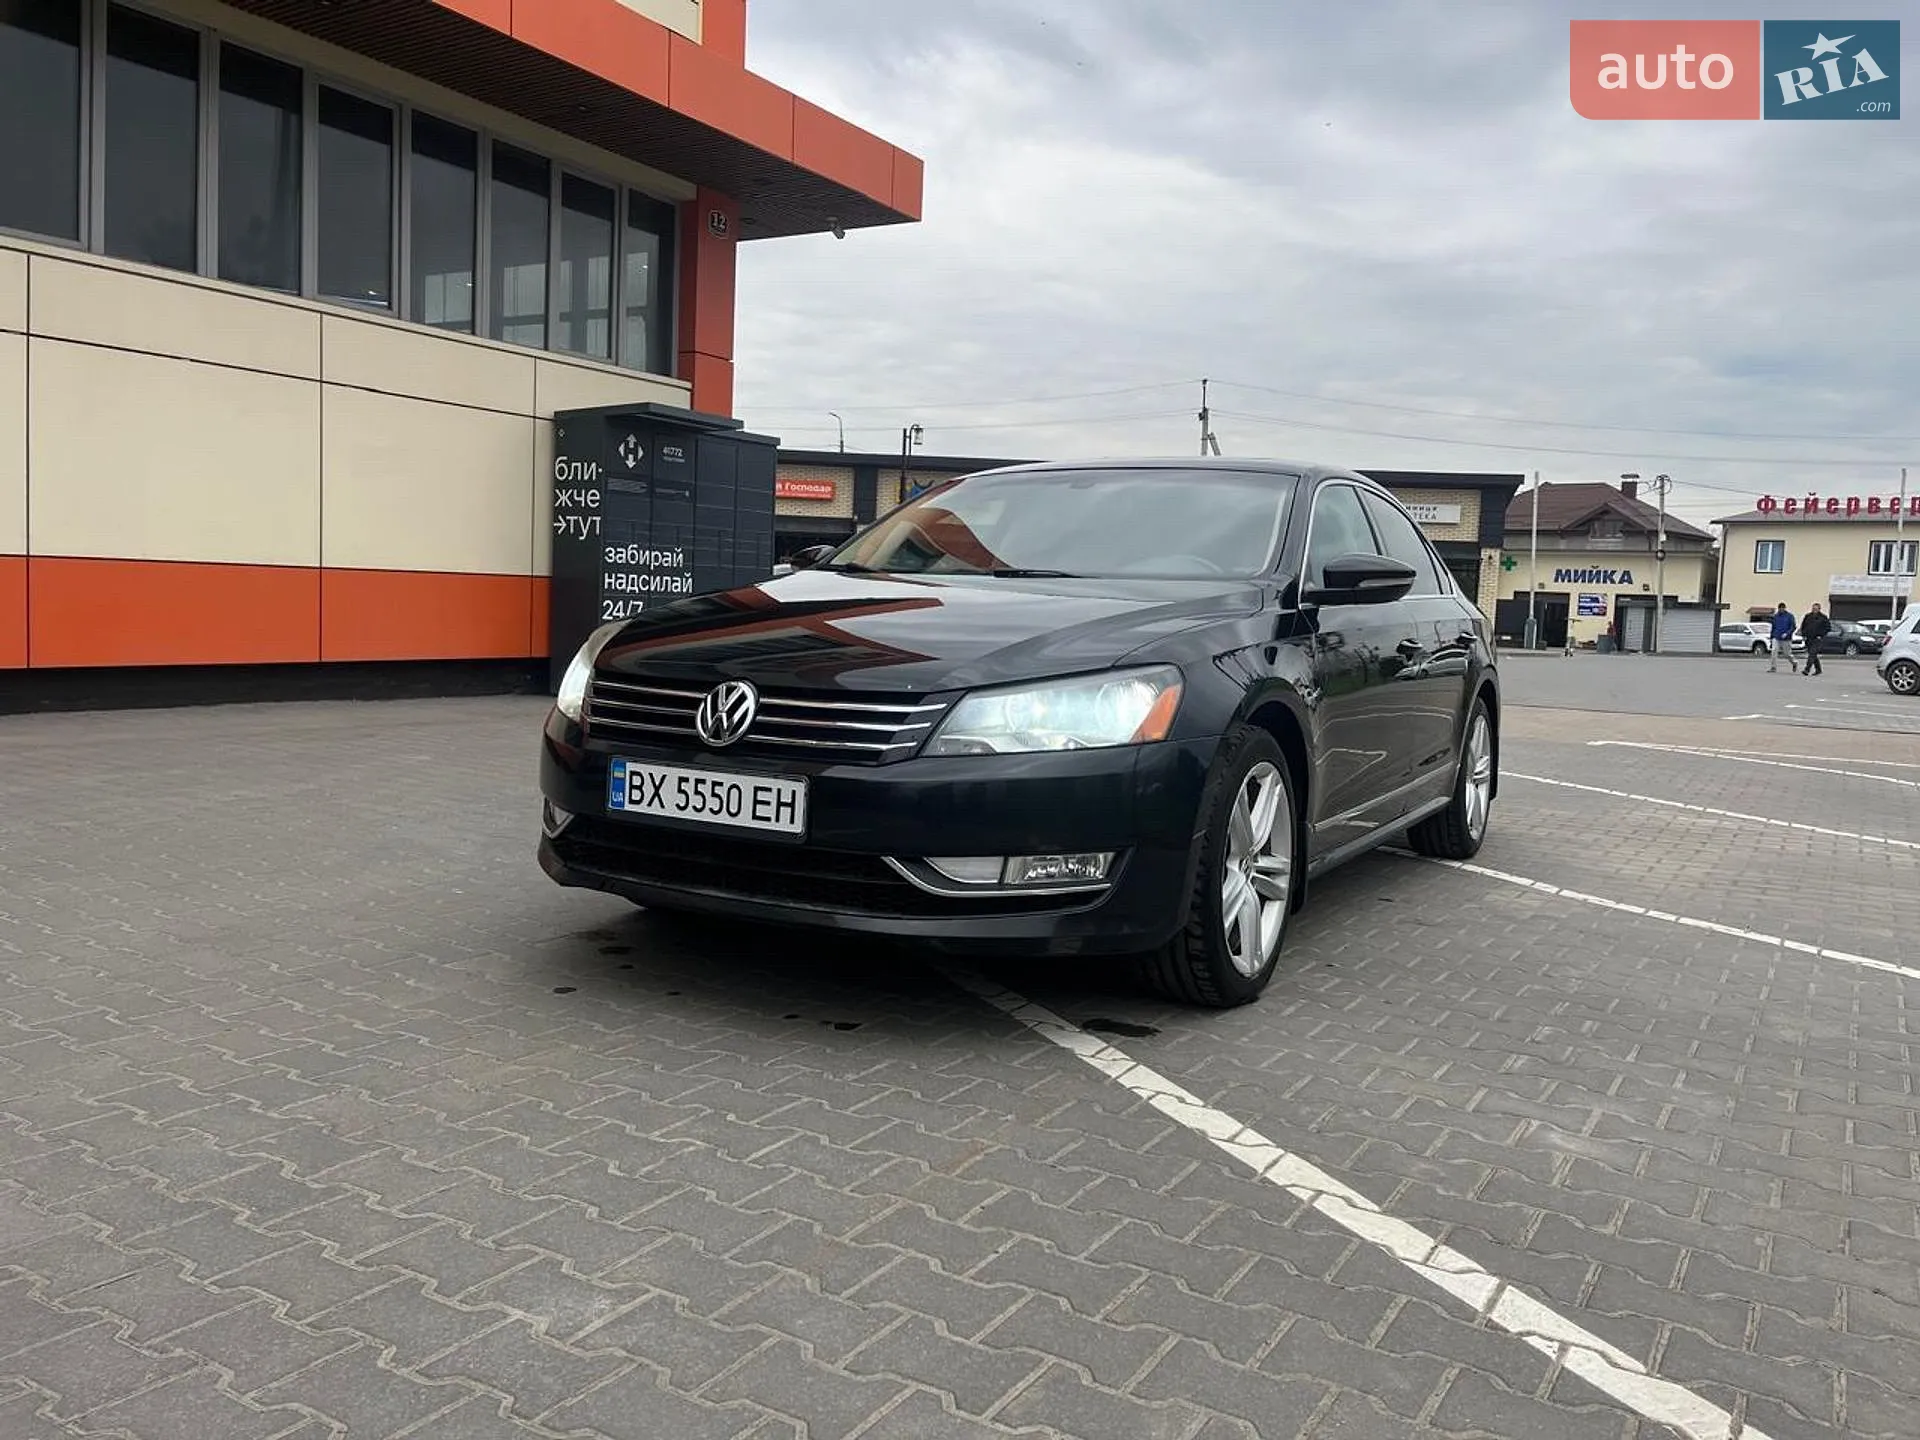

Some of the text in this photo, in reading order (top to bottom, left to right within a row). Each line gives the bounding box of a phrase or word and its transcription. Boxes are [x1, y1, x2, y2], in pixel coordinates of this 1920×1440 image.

[554, 488, 600, 508] жче
[567, 515, 601, 540] тут
[604, 544, 684, 570] забирай
[604, 572, 693, 593] надсилай
[1554, 565, 1633, 584] МИЙКА
[602, 600, 643, 620] 24/7
[628, 770, 796, 824] BX 5550 EH
